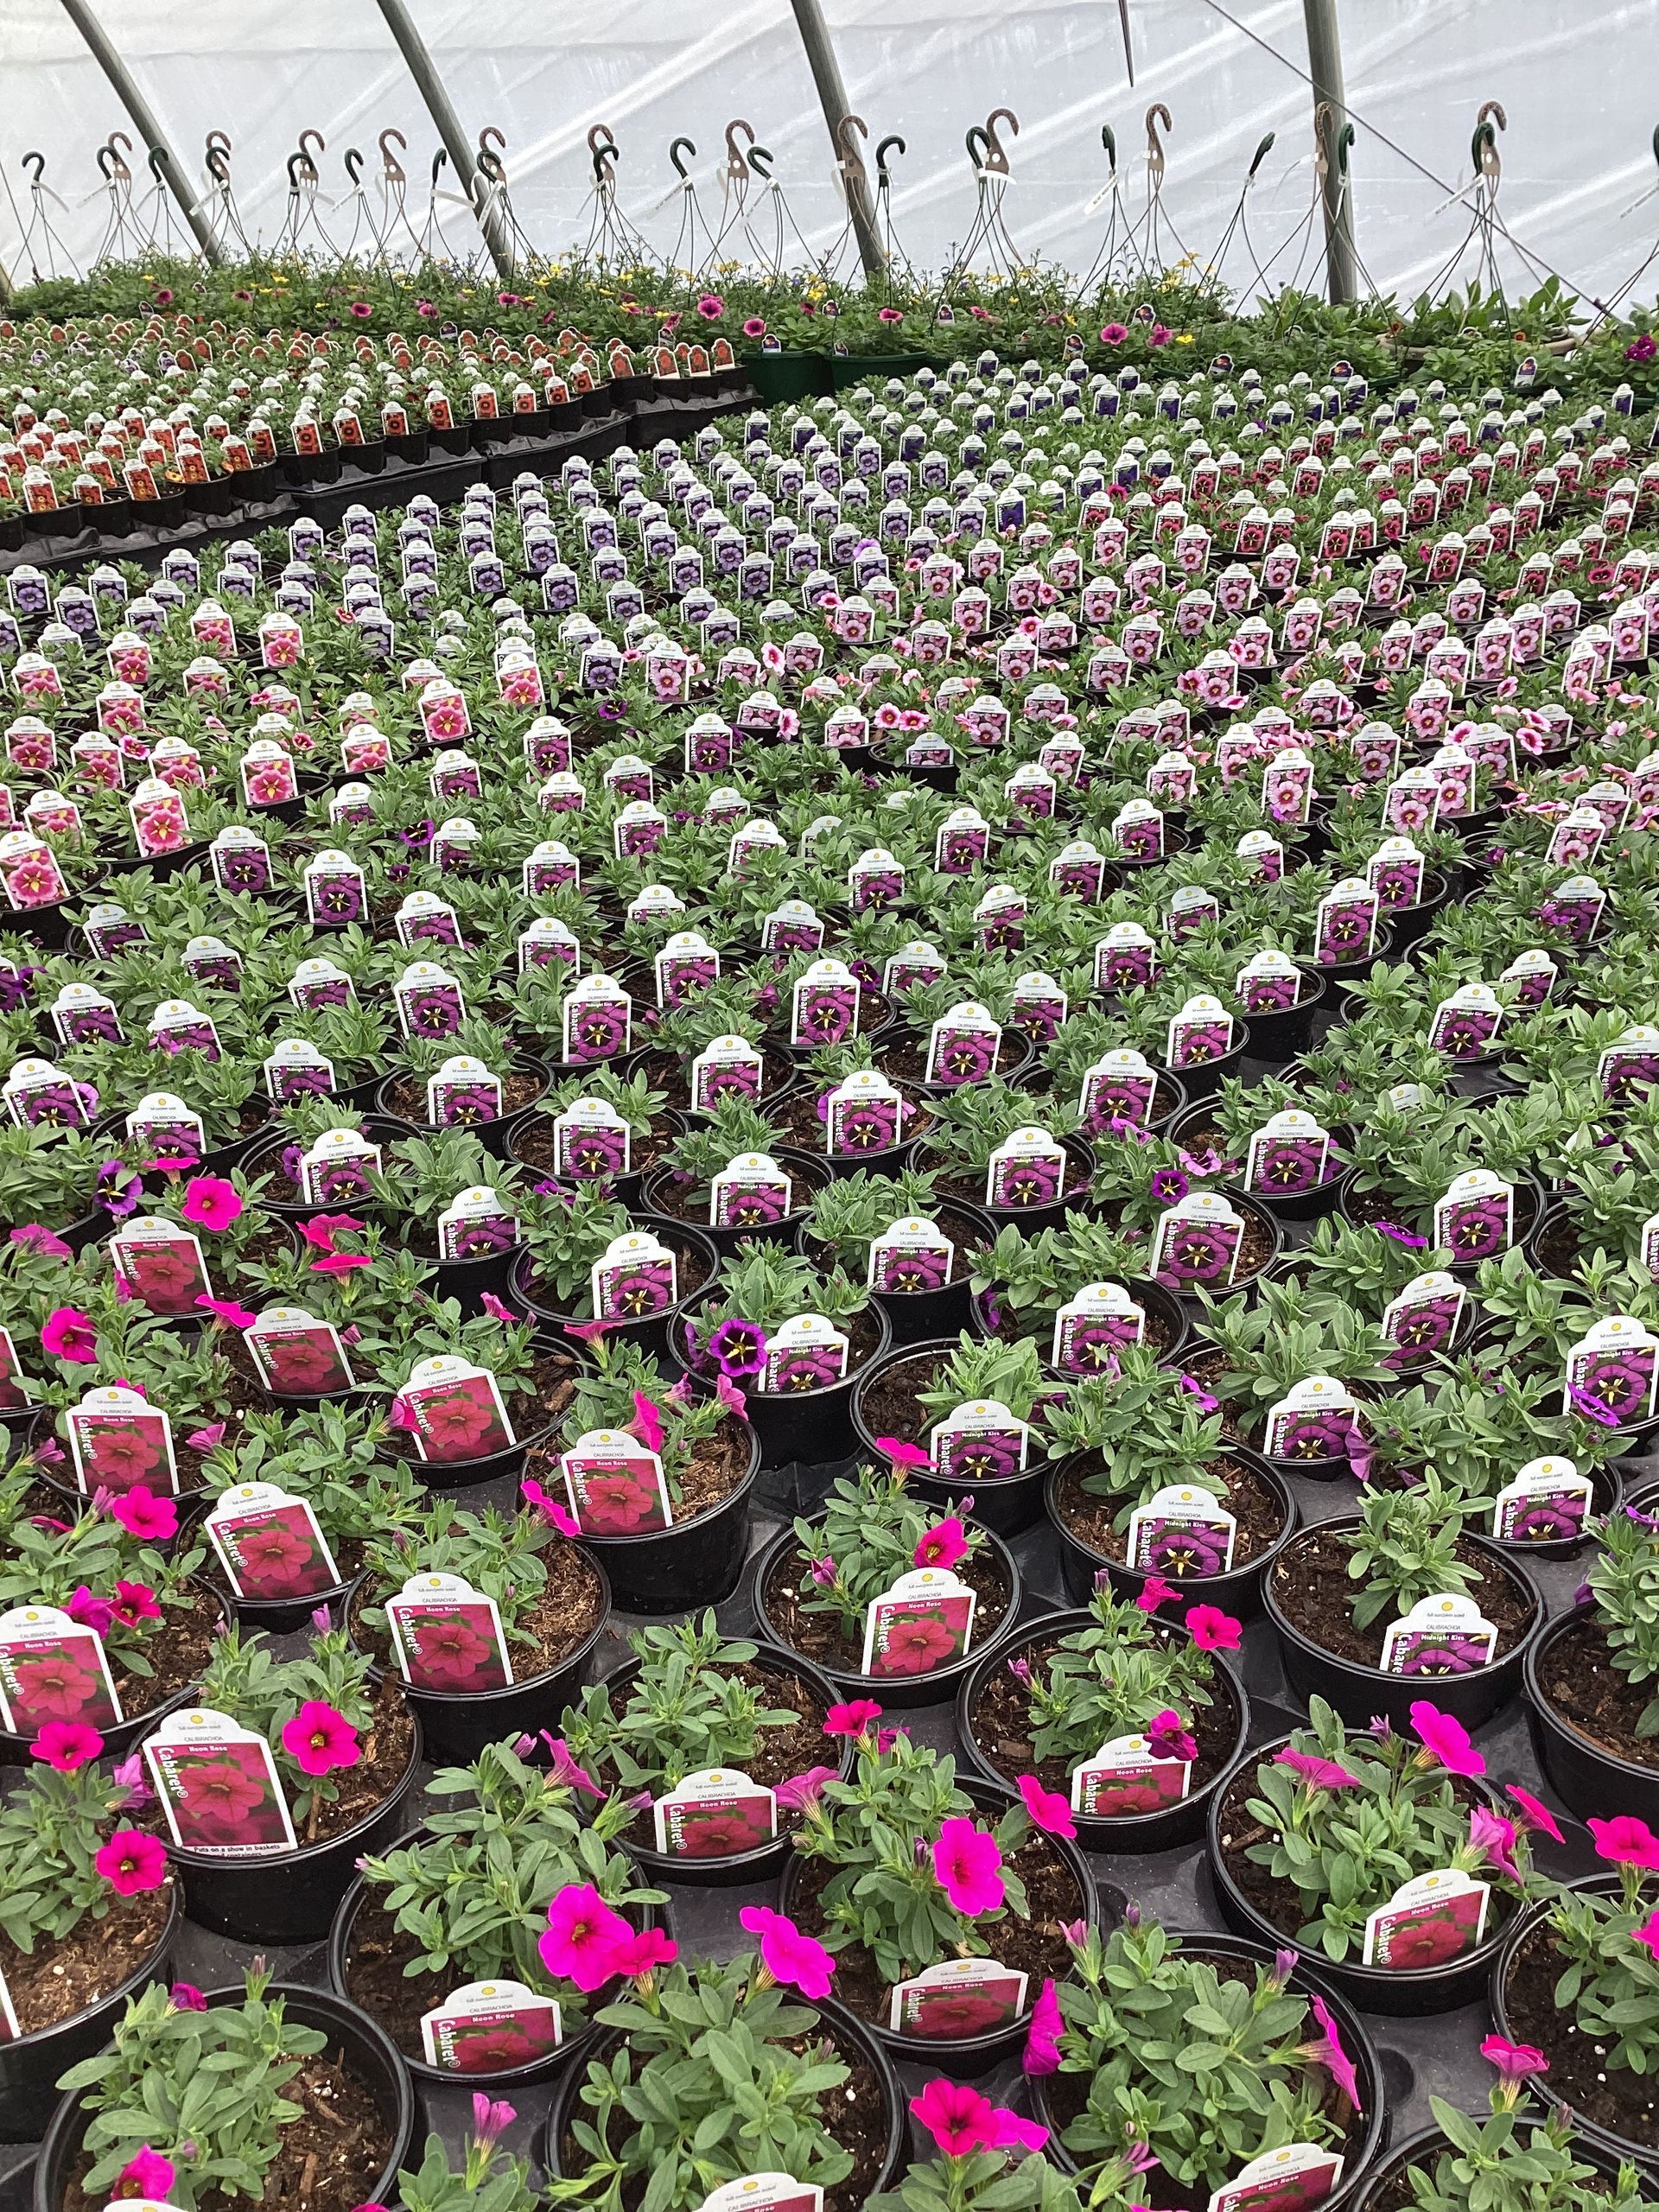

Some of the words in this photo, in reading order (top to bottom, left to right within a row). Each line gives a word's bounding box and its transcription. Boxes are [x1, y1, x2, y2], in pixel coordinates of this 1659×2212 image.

[244, 1515, 261, 1523] Neon
[262, 1511, 276, 1520] Rose
[1410, 1906, 1430, 1916] Neon
[1431, 1900, 1449, 1910] Rose
